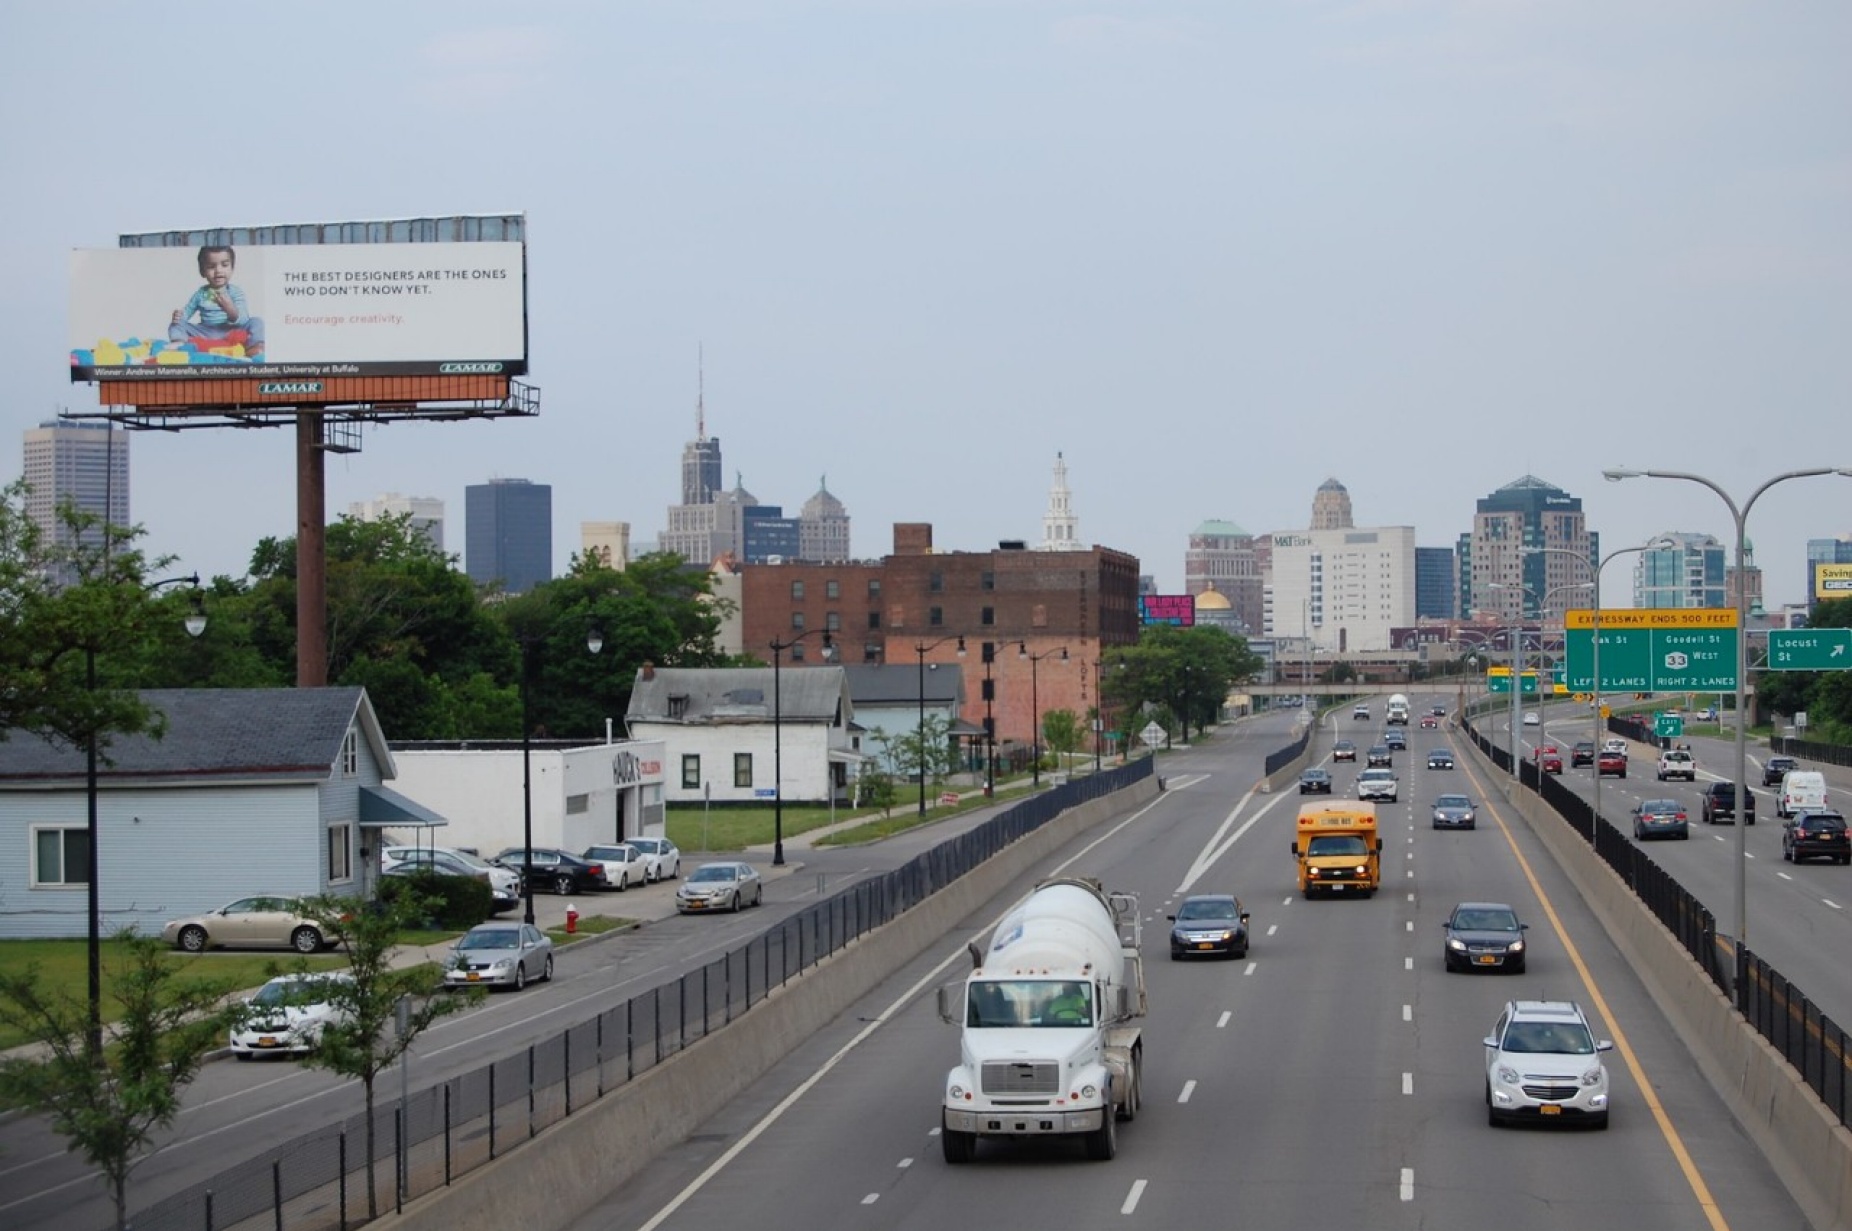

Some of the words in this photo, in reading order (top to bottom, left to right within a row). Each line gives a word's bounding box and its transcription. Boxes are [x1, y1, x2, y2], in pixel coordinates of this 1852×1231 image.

[284, 271, 308, 281] THE
[312, 271, 342, 281] BEST
[345, 270, 415, 281] DESIGNERS
[417, 270, 441, 280] ARE
[443, 270, 469, 280] THE
[471, 269, 507, 279] ONES
[284, 286, 316, 296] WHO
[319, 286, 360, 296] DON'T
[362, 285, 403, 295] KNOW
[406, 284, 432, 295] YET.
[284, 314, 345, 326] Encourage
[349, 312, 405, 325] creativity.
[94, 367, 124, 376] Winner:
[126, 367, 156, 376] Andrew
[200, 365, 247, 375] Architecture
[249, 365, 281, 375] Student,
[283, 364, 320, 375] University
[322, 365, 330, 374] at
[332, 364, 359, 374] Buffalo
[445, 363, 498, 373] LAMAR
[263, 383, 318, 393] LAMAR
[1578, 615, 1645, 624] EXPRESSWAY
[1651, 615, 1678, 624] ENDS
[1682, 615, 1702, 623] 500
[1707, 614, 1731, 623] FEET
[1616, 635, 1628, 644] St
[1666, 635, 1704, 644] Goodell
[1709, 635, 1720, 644] St
[1777, 638, 1818, 648] Locust
[1667, 655, 1687, 666] 33
[1777, 652, 1791, 661] St
[1602, 677, 1609, 686] 2
[1612, 677, 1646, 686] LANES
[1657, 677, 1687, 686] RIGHT
[1690, 677, 1698, 686] 2
[1702, 677, 1736, 686] LANES
